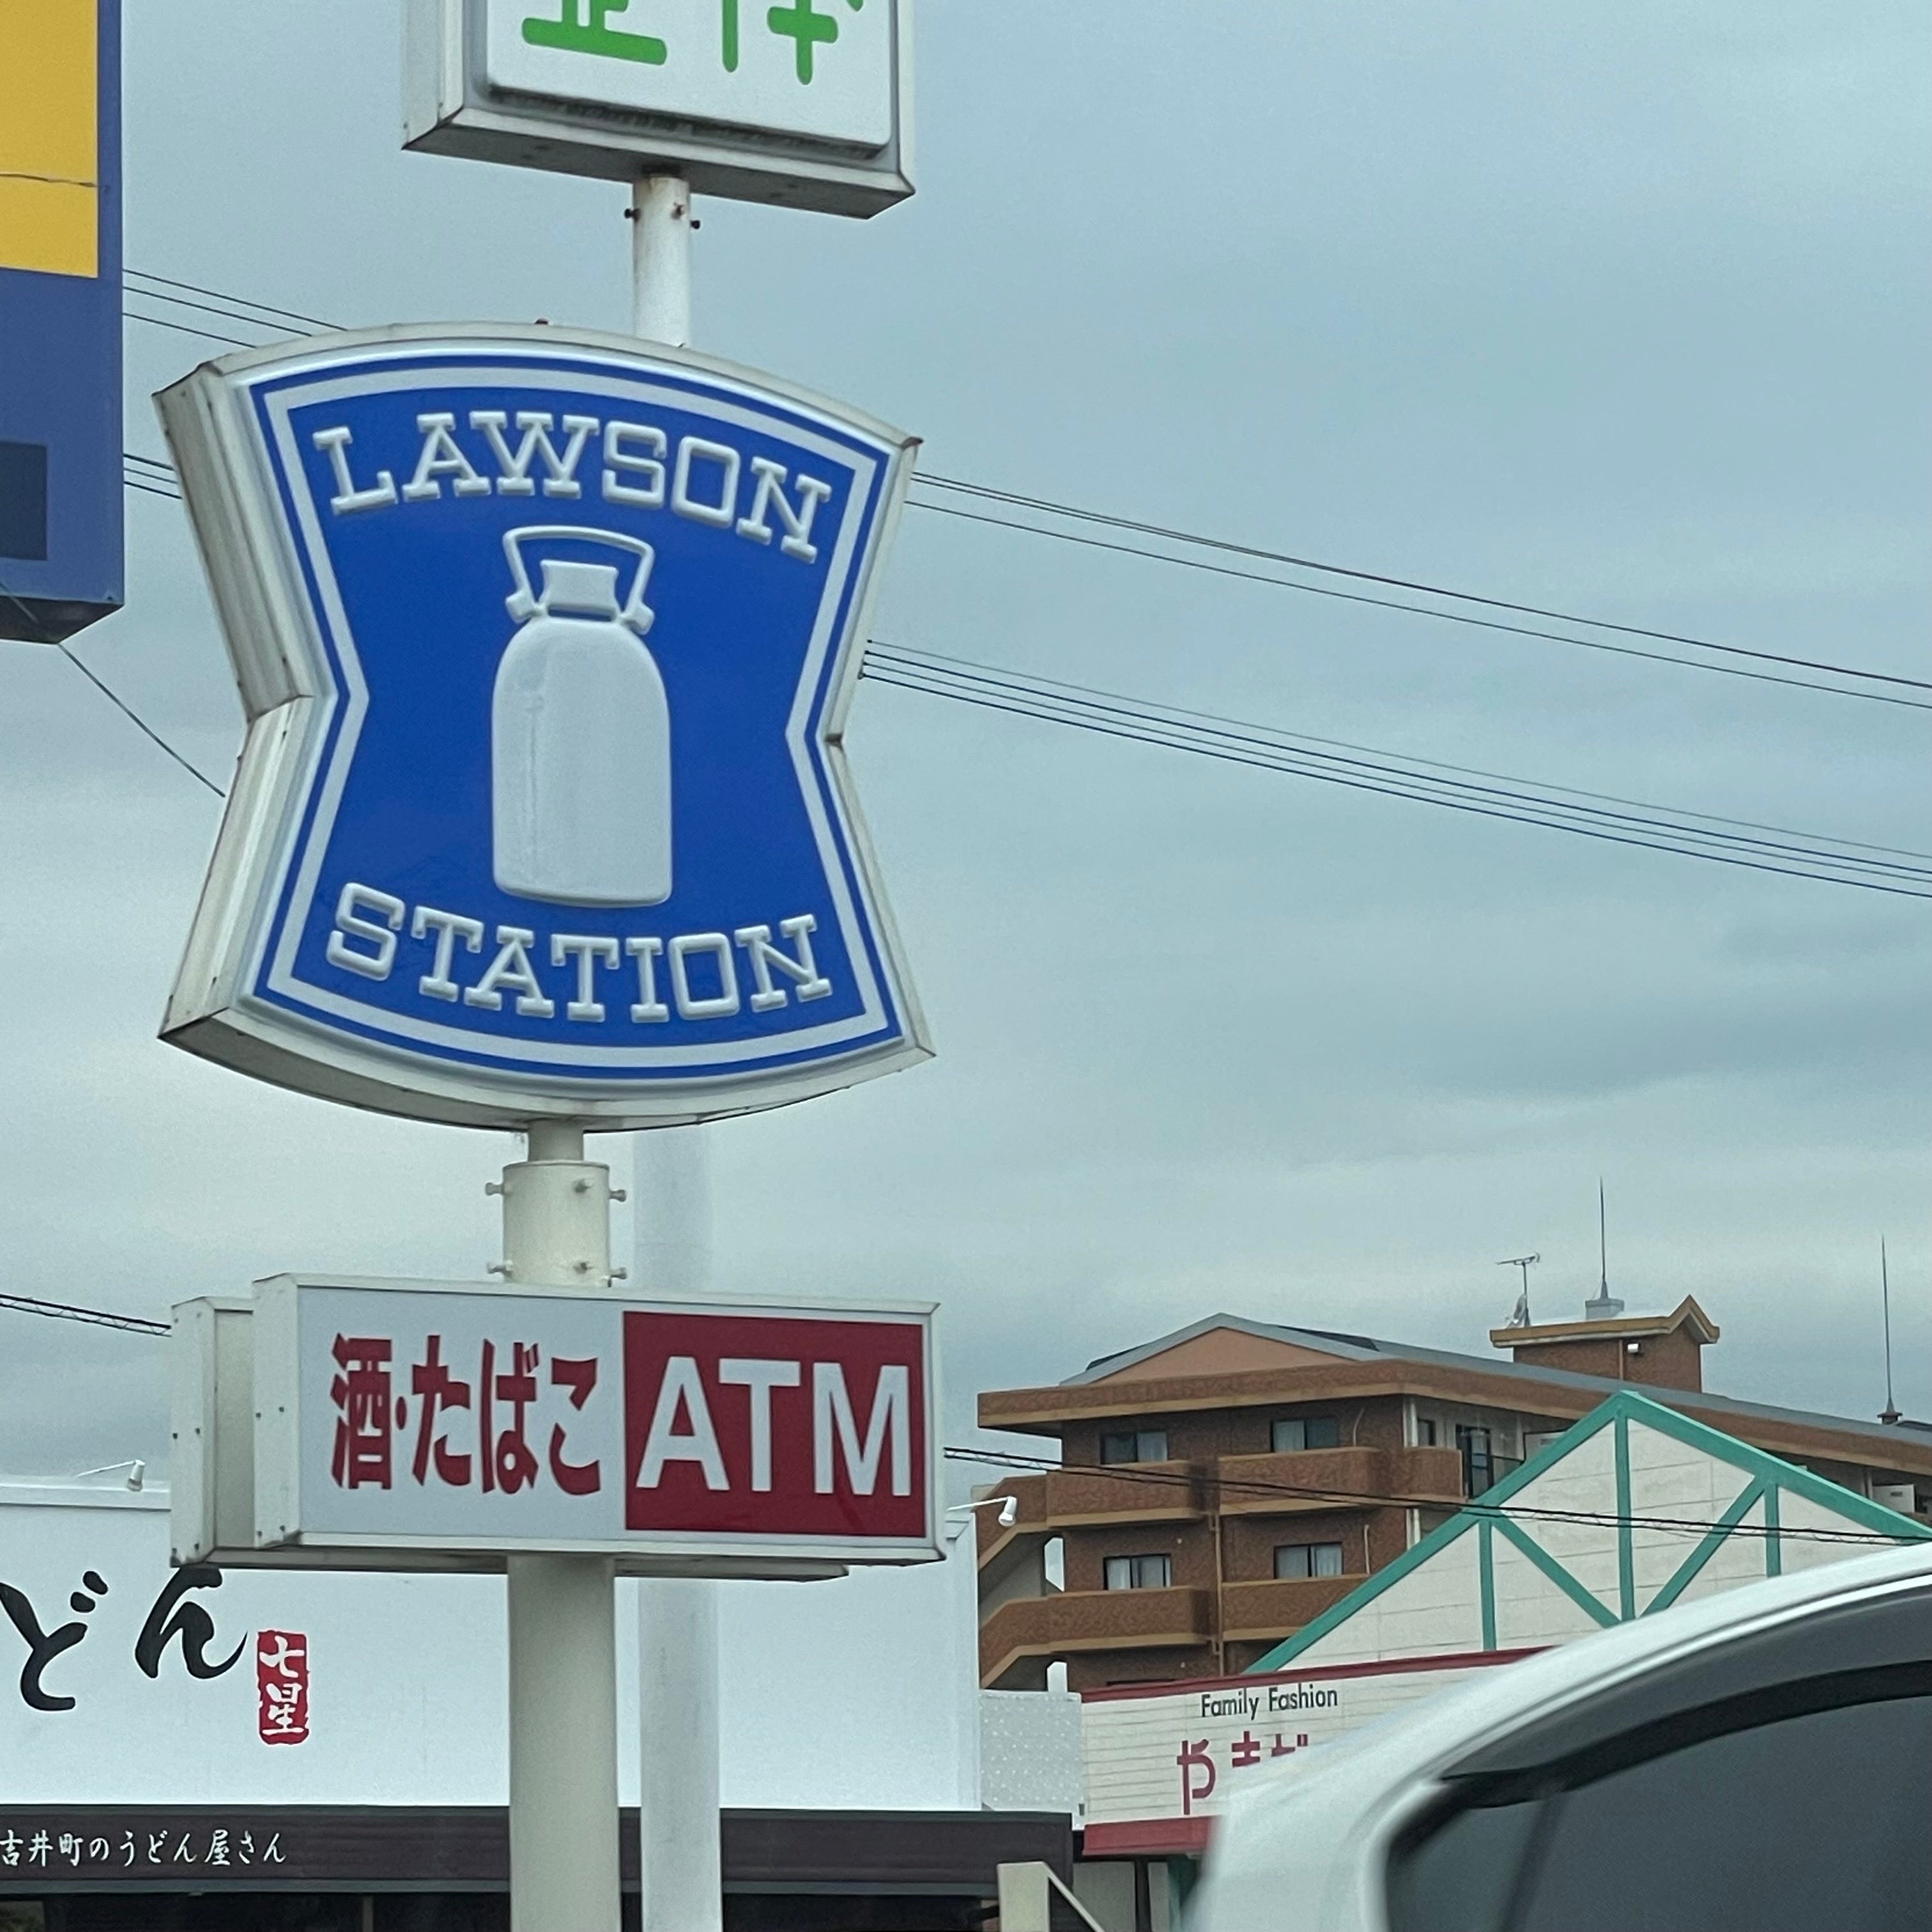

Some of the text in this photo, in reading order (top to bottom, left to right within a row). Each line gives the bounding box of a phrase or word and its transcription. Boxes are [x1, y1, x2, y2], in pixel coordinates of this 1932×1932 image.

[312, 411, 832, 564] LAWSON
[326, 882, 833, 1022] STATION
[635, 1355, 912, 1497] ATM
[259, 1636, 305, 1735] 七星
[1201, 1683, 1338, 1721] Family Fashion
[0, 1829, 287, 1867] 吉井町のうどん屋さん
